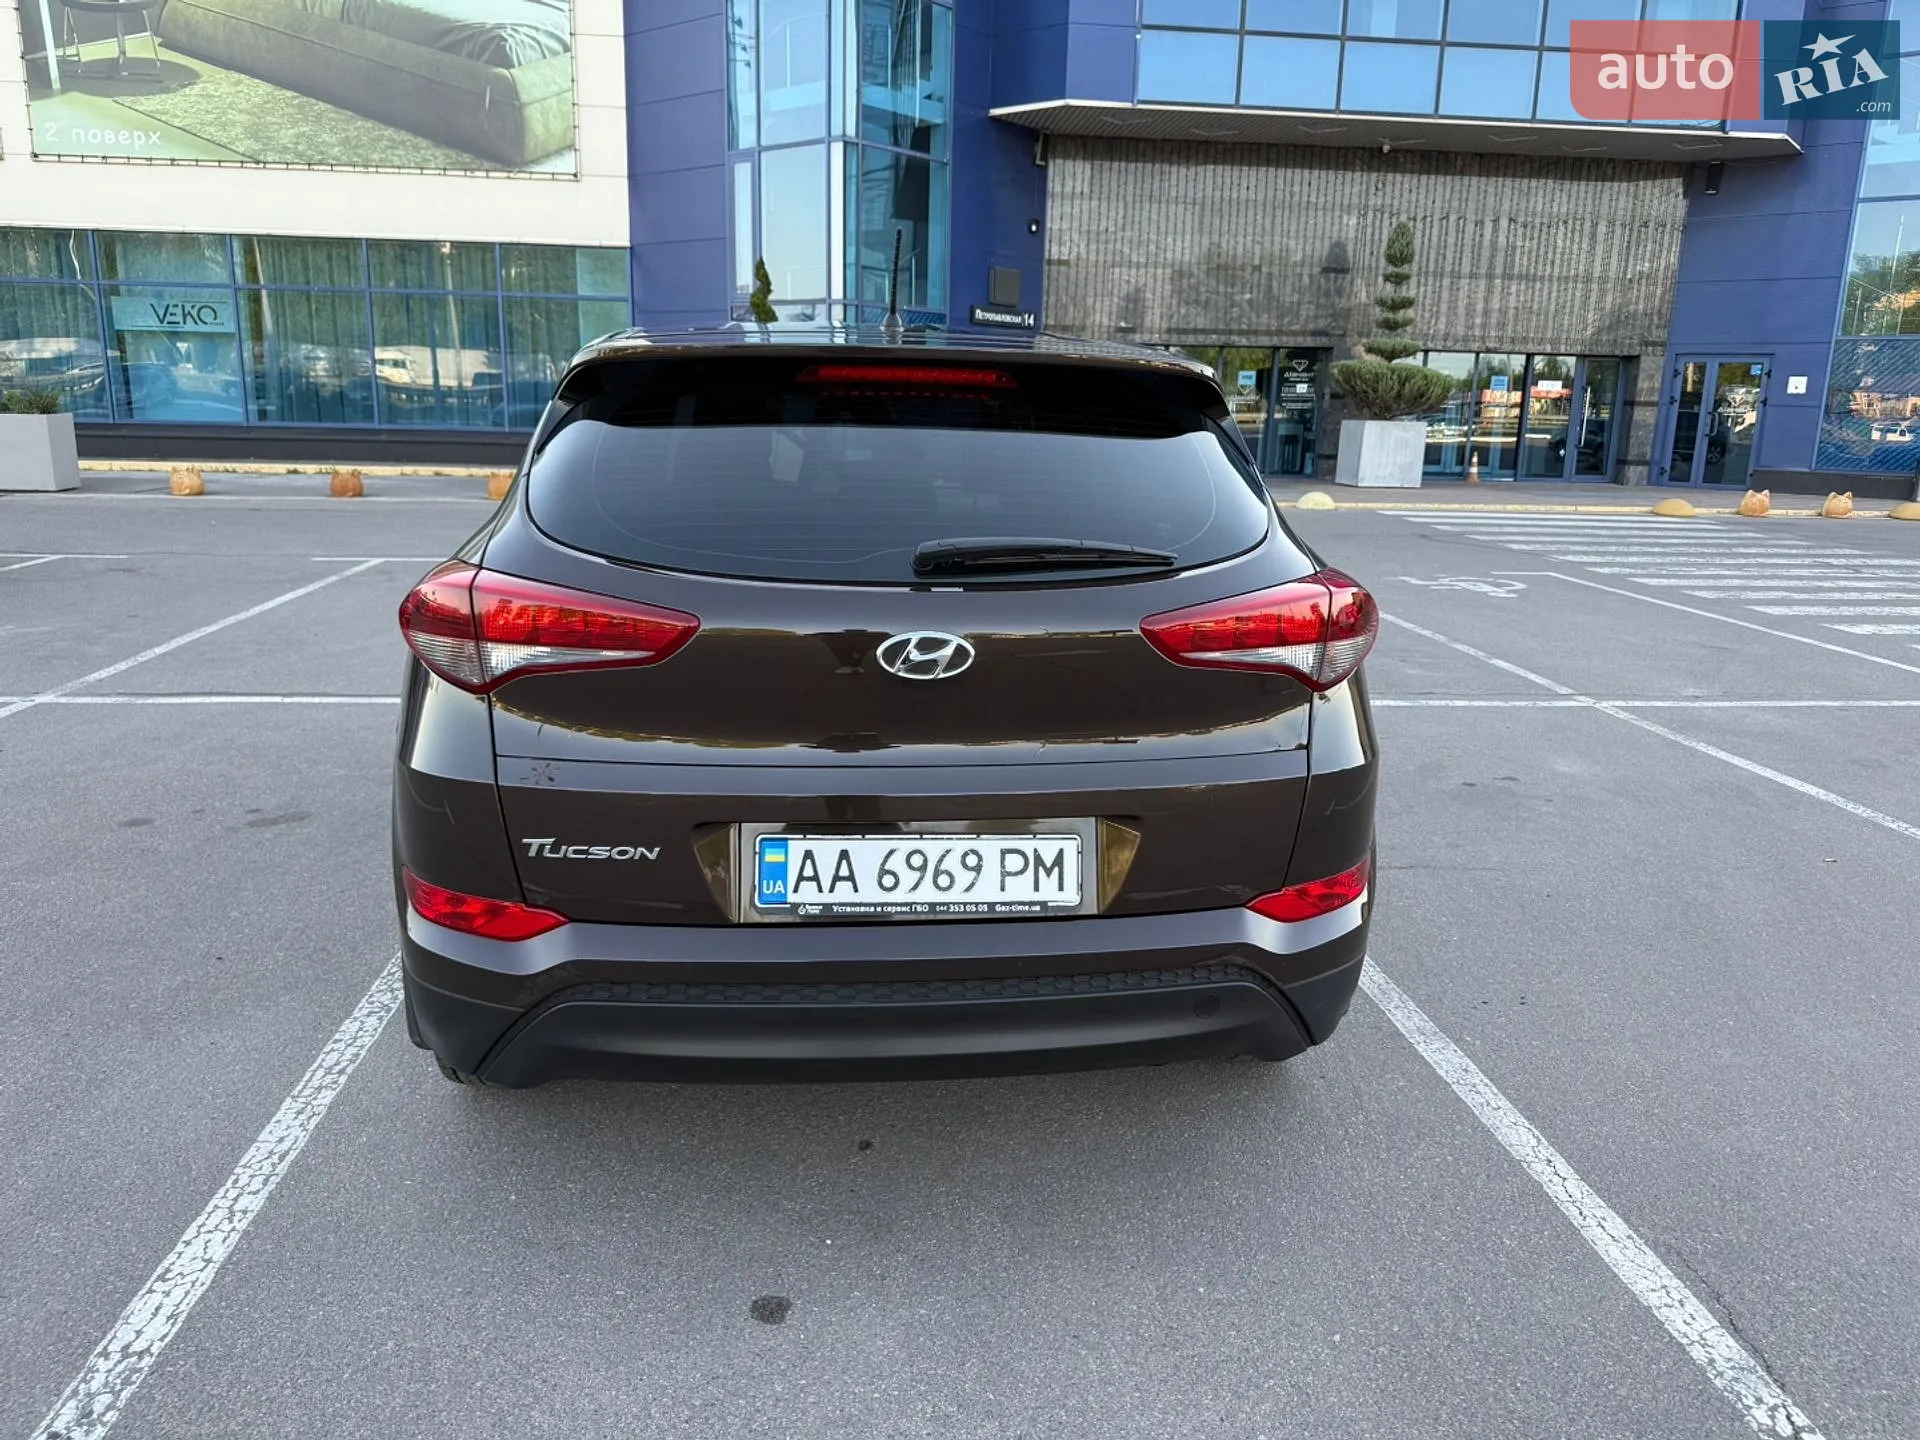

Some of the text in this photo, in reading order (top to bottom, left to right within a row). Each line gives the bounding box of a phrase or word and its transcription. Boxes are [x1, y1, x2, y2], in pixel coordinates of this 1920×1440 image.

[44, 122, 161, 150] 2 поверх
[150, 303, 217, 325] VEKO
[1023, 312, 1035, 327] 14
[521, 838, 660, 860] TUCSON
[792, 848, 1064, 893] AA 6969 PM
[763, 880, 785, 894] UA
[832, 905, 874, 913] Установка
[883, 905, 911, 914] сервис
[911, 904, 929, 912] ГБО
[948, 904, 964, 912] 353
[965, 904, 977, 912] 05
